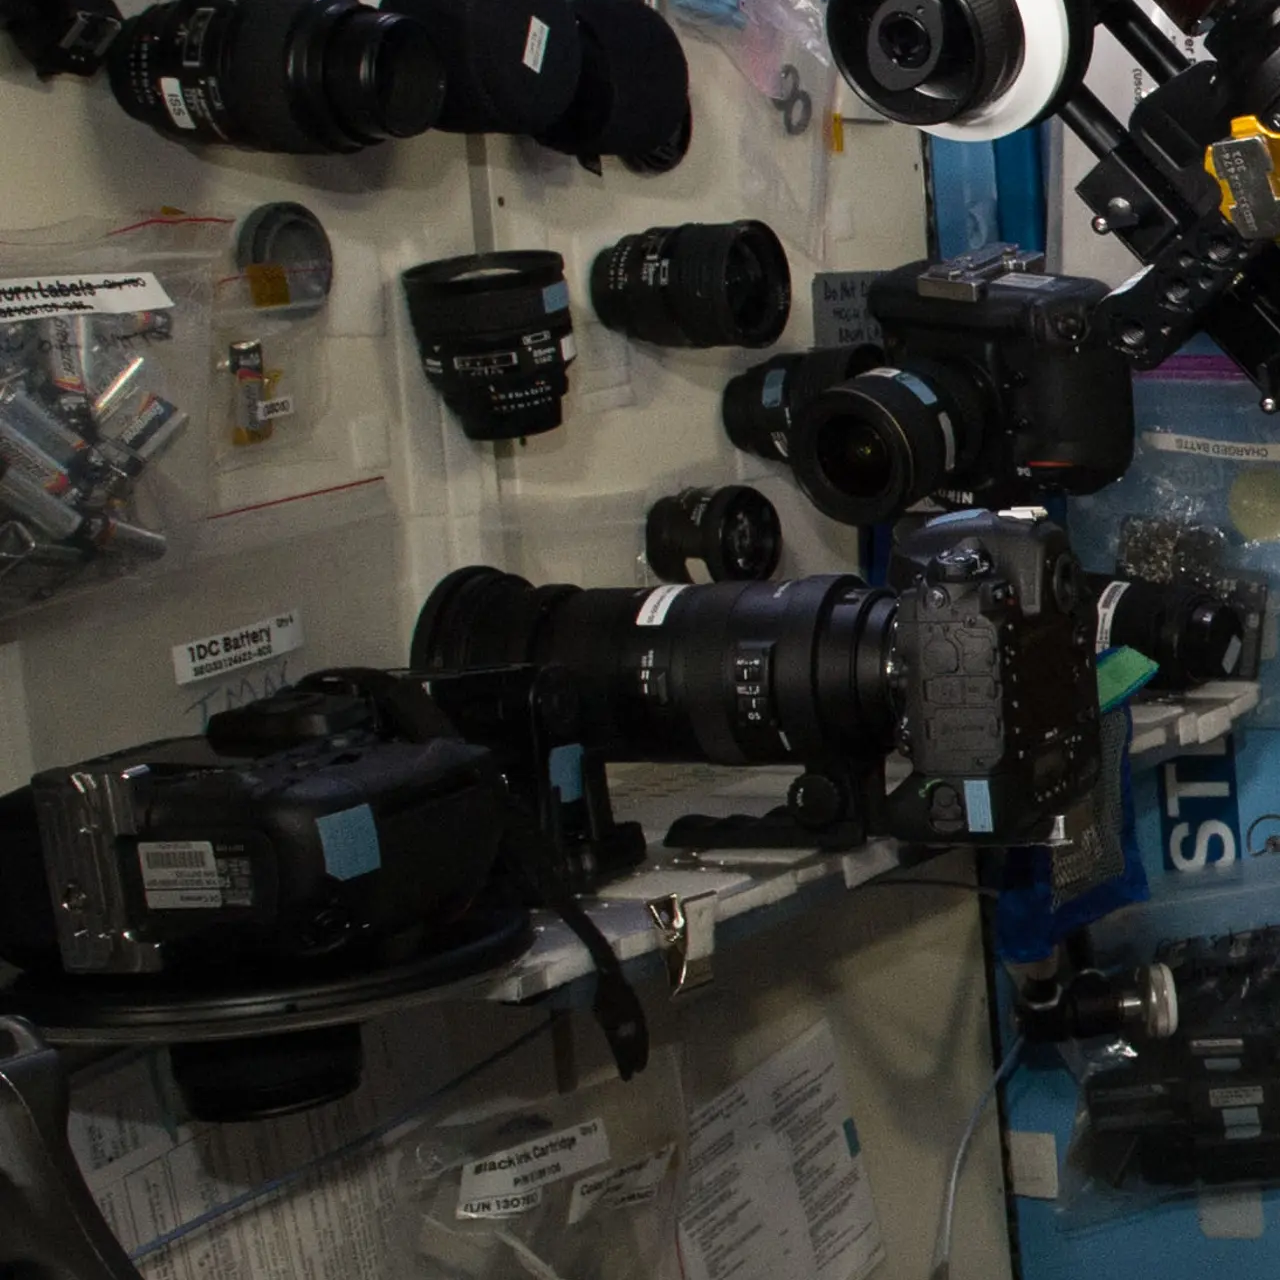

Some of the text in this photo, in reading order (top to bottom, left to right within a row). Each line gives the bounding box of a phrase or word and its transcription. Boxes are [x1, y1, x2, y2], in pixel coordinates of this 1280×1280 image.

[1175, 438, 1269, 458] CHARGED BATTS
[187, 637, 221, 662] 1DC
[222, 624, 271, 652] Battery
[1165, 753, 1236, 873] ST
[474, 1156, 517, 1175] Black
[532, 1135, 577, 1160] Cartridge
